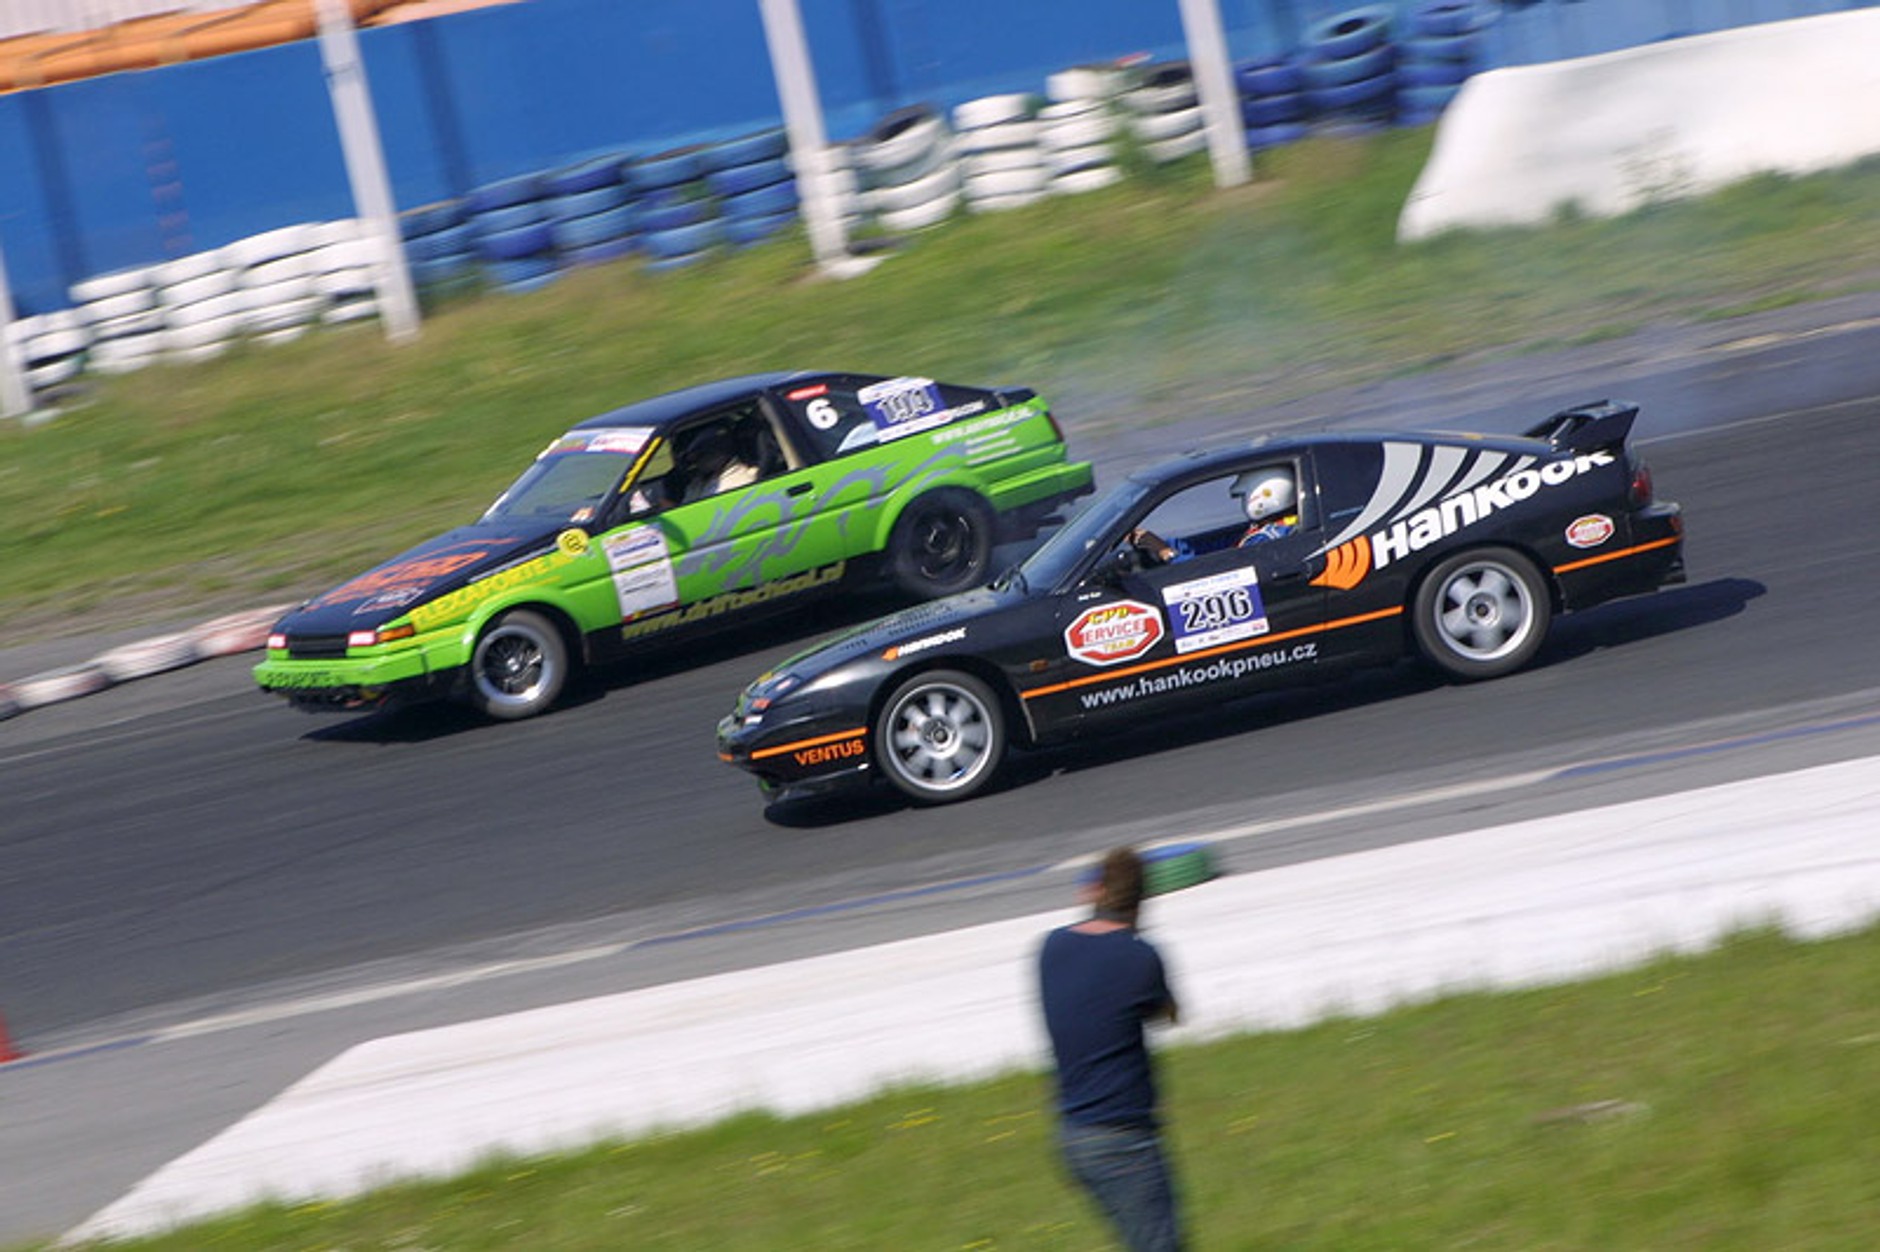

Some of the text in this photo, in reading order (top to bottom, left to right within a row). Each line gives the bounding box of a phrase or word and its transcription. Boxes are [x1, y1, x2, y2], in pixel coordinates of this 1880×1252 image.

[806, 398, 838, 429] 6
[1181, 589, 1252, 632] 296
[1080, 642, 1318, 709] www.hankookpneu.cz
[793, 738, 865, 766] VENTUS
